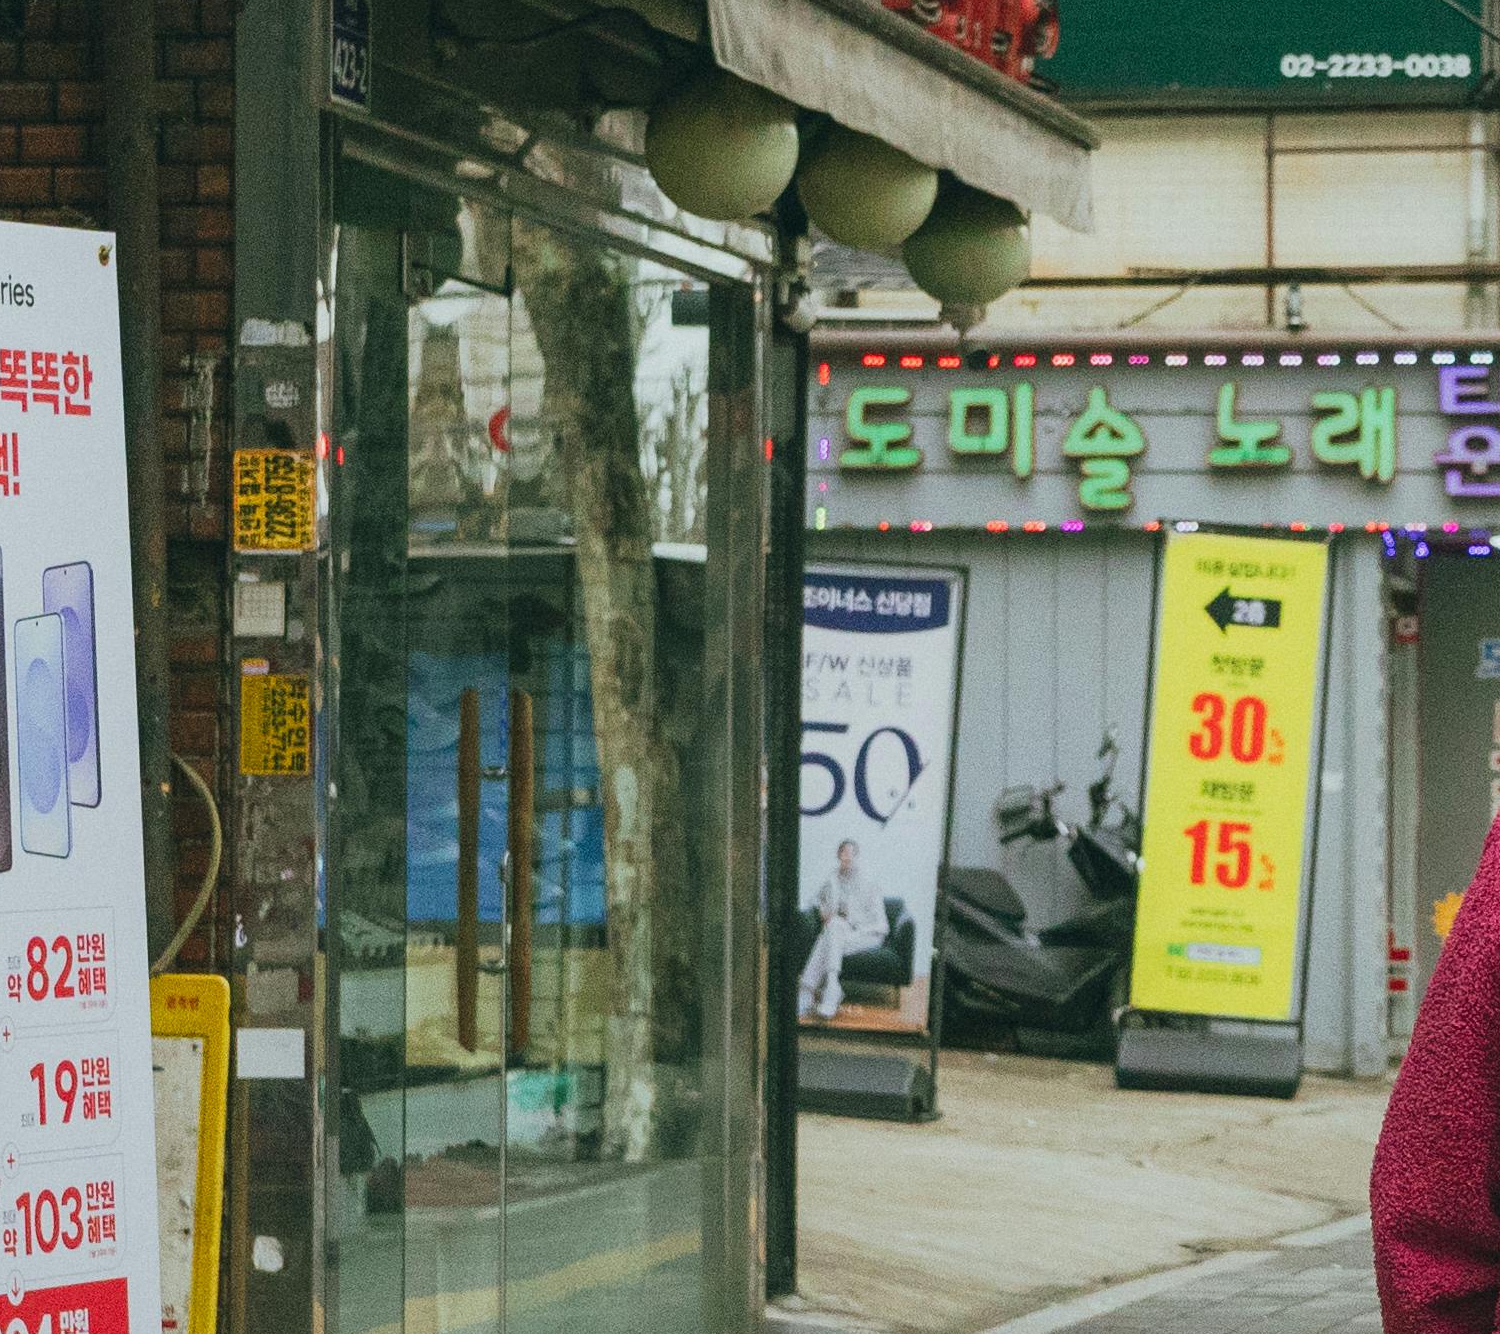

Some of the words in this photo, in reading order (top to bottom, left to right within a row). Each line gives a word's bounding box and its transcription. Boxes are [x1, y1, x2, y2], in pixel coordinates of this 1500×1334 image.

[1280, 54, 1471, 78] 02-2233-0038
[839, 382, 1145, 511] 도미솔
[1208, 382, 1397, 483] 노래
[1189, 691, 1268, 764] 30
[1183, 820, 1252, 889] 15
[76, 932, 107, 964] 만원
[7, 973, 22, 1003] 약
[27, 935, 75, 1002] 82
[78, 966, 107, 996] 혜택
[81, 1056, 111, 1088] 만원
[30, 1060, 78, 1126] 19
[83, 1090, 112, 1121] 혜택
[86, 1180, 116, 1212] 만원
[3, 1227, 17, 1257] 약
[16, 1186, 84, 1257] 103
[88, 1214, 116, 1245] 혜택
